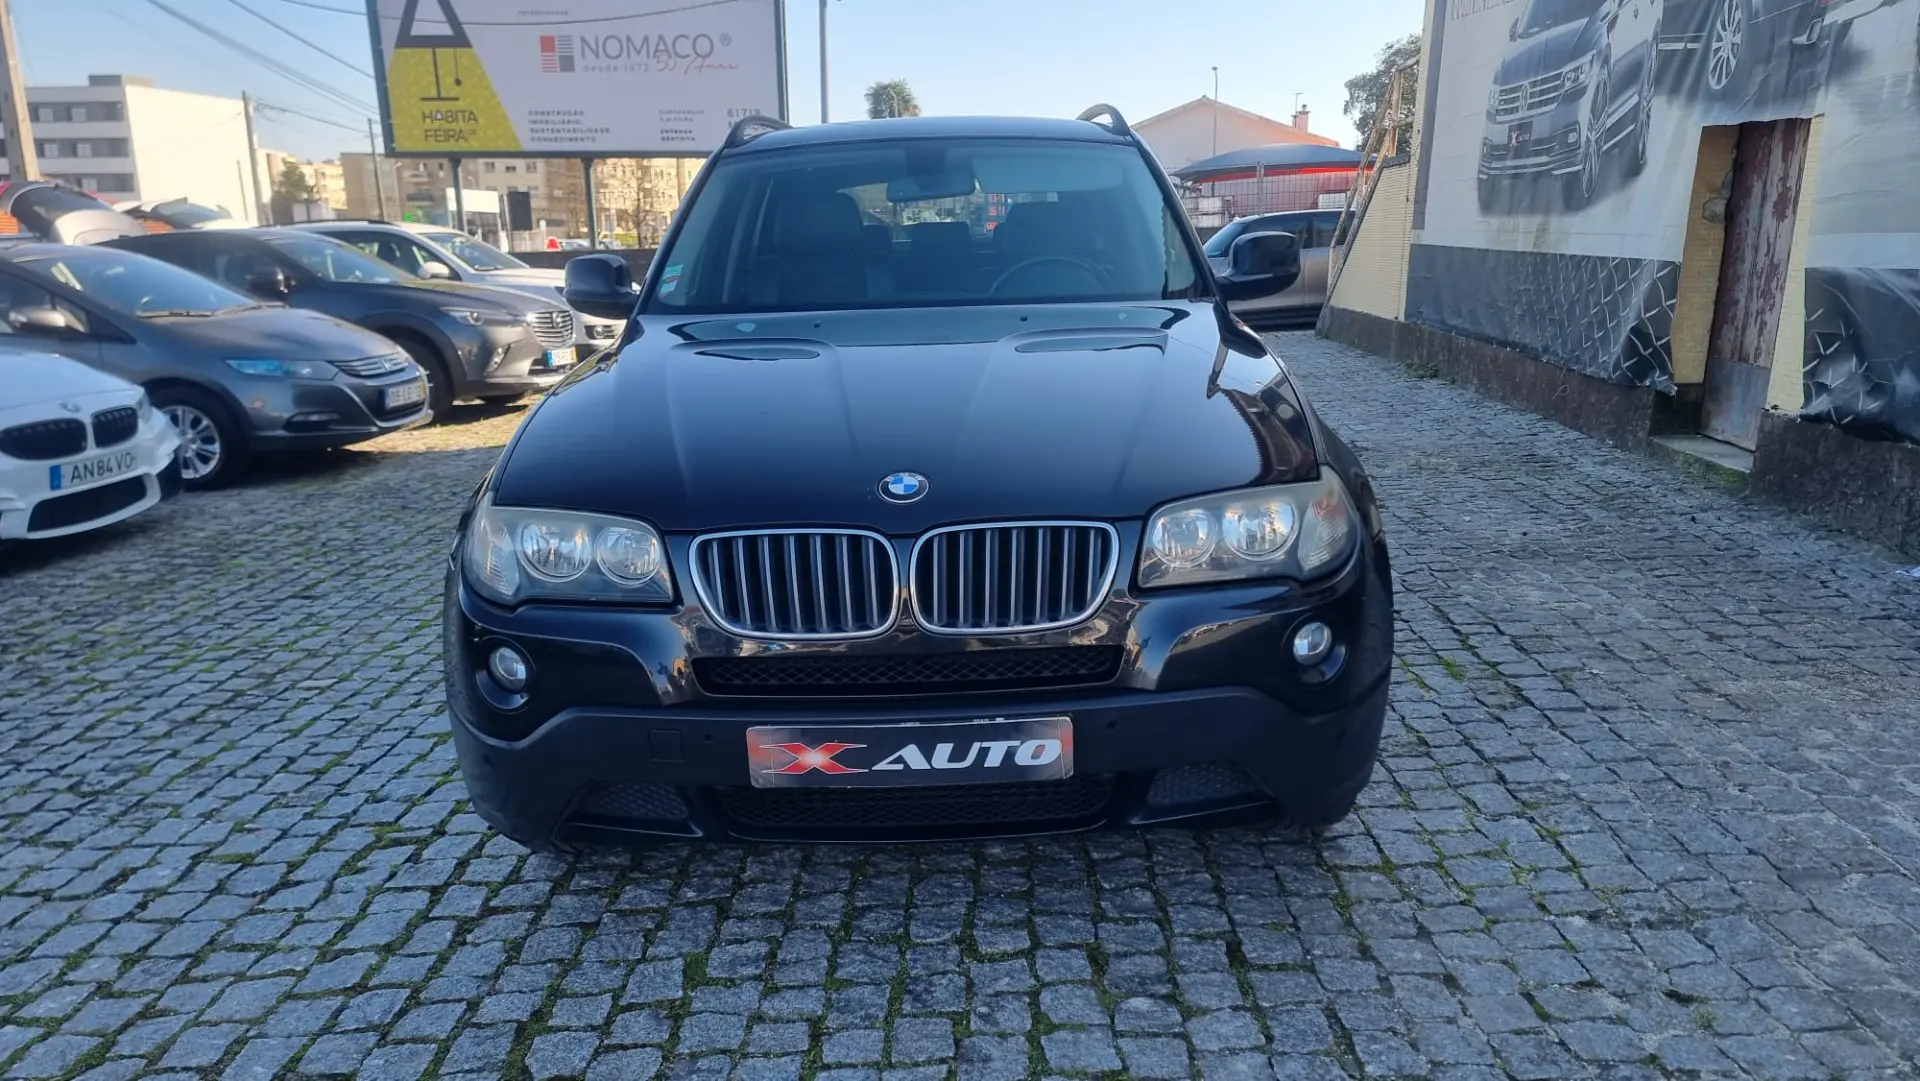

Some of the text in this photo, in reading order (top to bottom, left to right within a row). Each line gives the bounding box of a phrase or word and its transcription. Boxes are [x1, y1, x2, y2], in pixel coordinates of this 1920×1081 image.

[580, 33, 715, 60] NOMACO
[422, 110, 478, 124] HABITA
[872, 739, 1062, 770] AUTO
